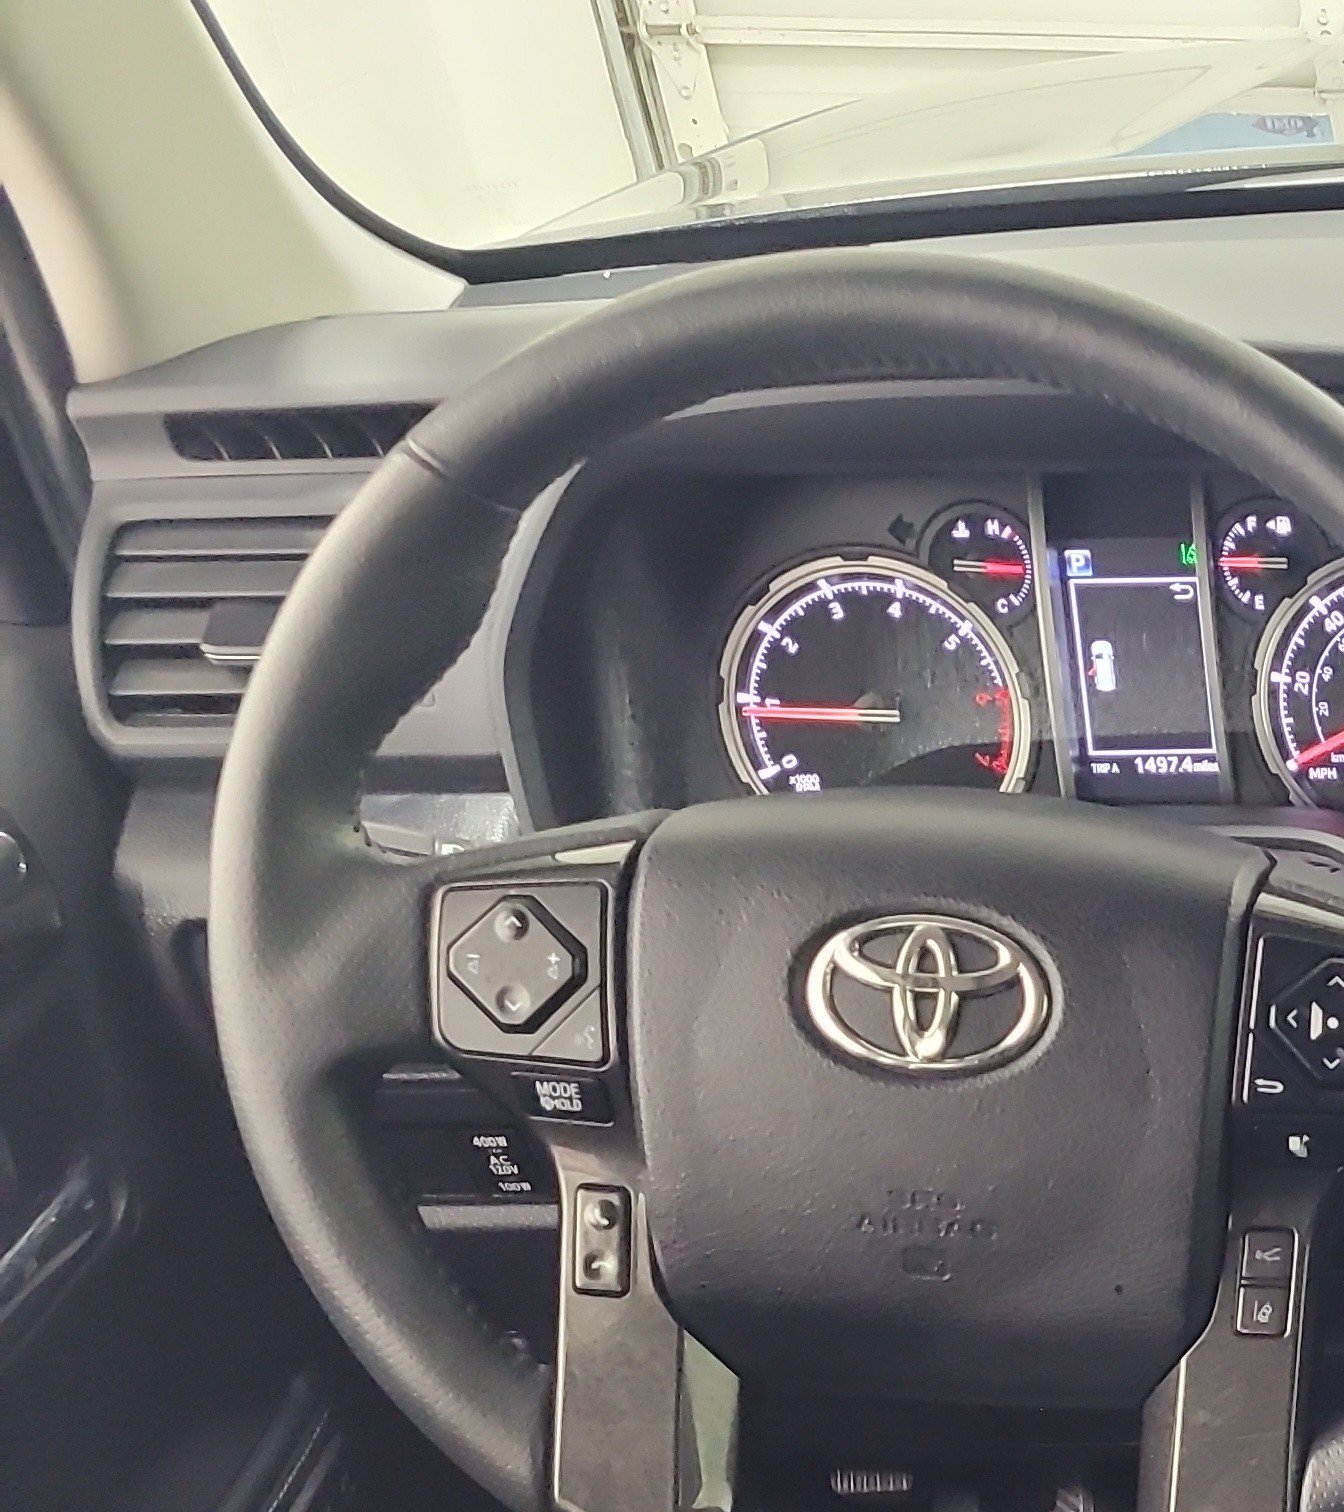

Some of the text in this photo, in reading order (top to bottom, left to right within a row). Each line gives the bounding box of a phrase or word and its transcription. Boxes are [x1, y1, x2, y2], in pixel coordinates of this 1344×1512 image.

[985, 518, 1000, 537] H
[1246, 515, 1258, 533] F
[1070, 554, 1086, 574] P
[828, 602, 844, 620] 3
[886, 601, 903, 618] 4
[995, 598, 1009, 614] C
[1254, 594, 1266, 611] E
[780, 636, 800, 655] 2
[943, 634, 961, 651] 5
[1293, 670, 1311, 696] 20
[1321, 666, 1334, 683] 40
[1318, 701, 1330, 717] 20
[781, 753, 798, 770] 0
[1090, 762, 1110, 774] TRIP
[1111, 762, 1121, 774] A
[1133, 756, 1193, 775] 1497.4
[1308, 766, 1338, 780] MPH
[535, 1080, 583, 1099] MODE
[489, 1155, 512, 1166] AC
